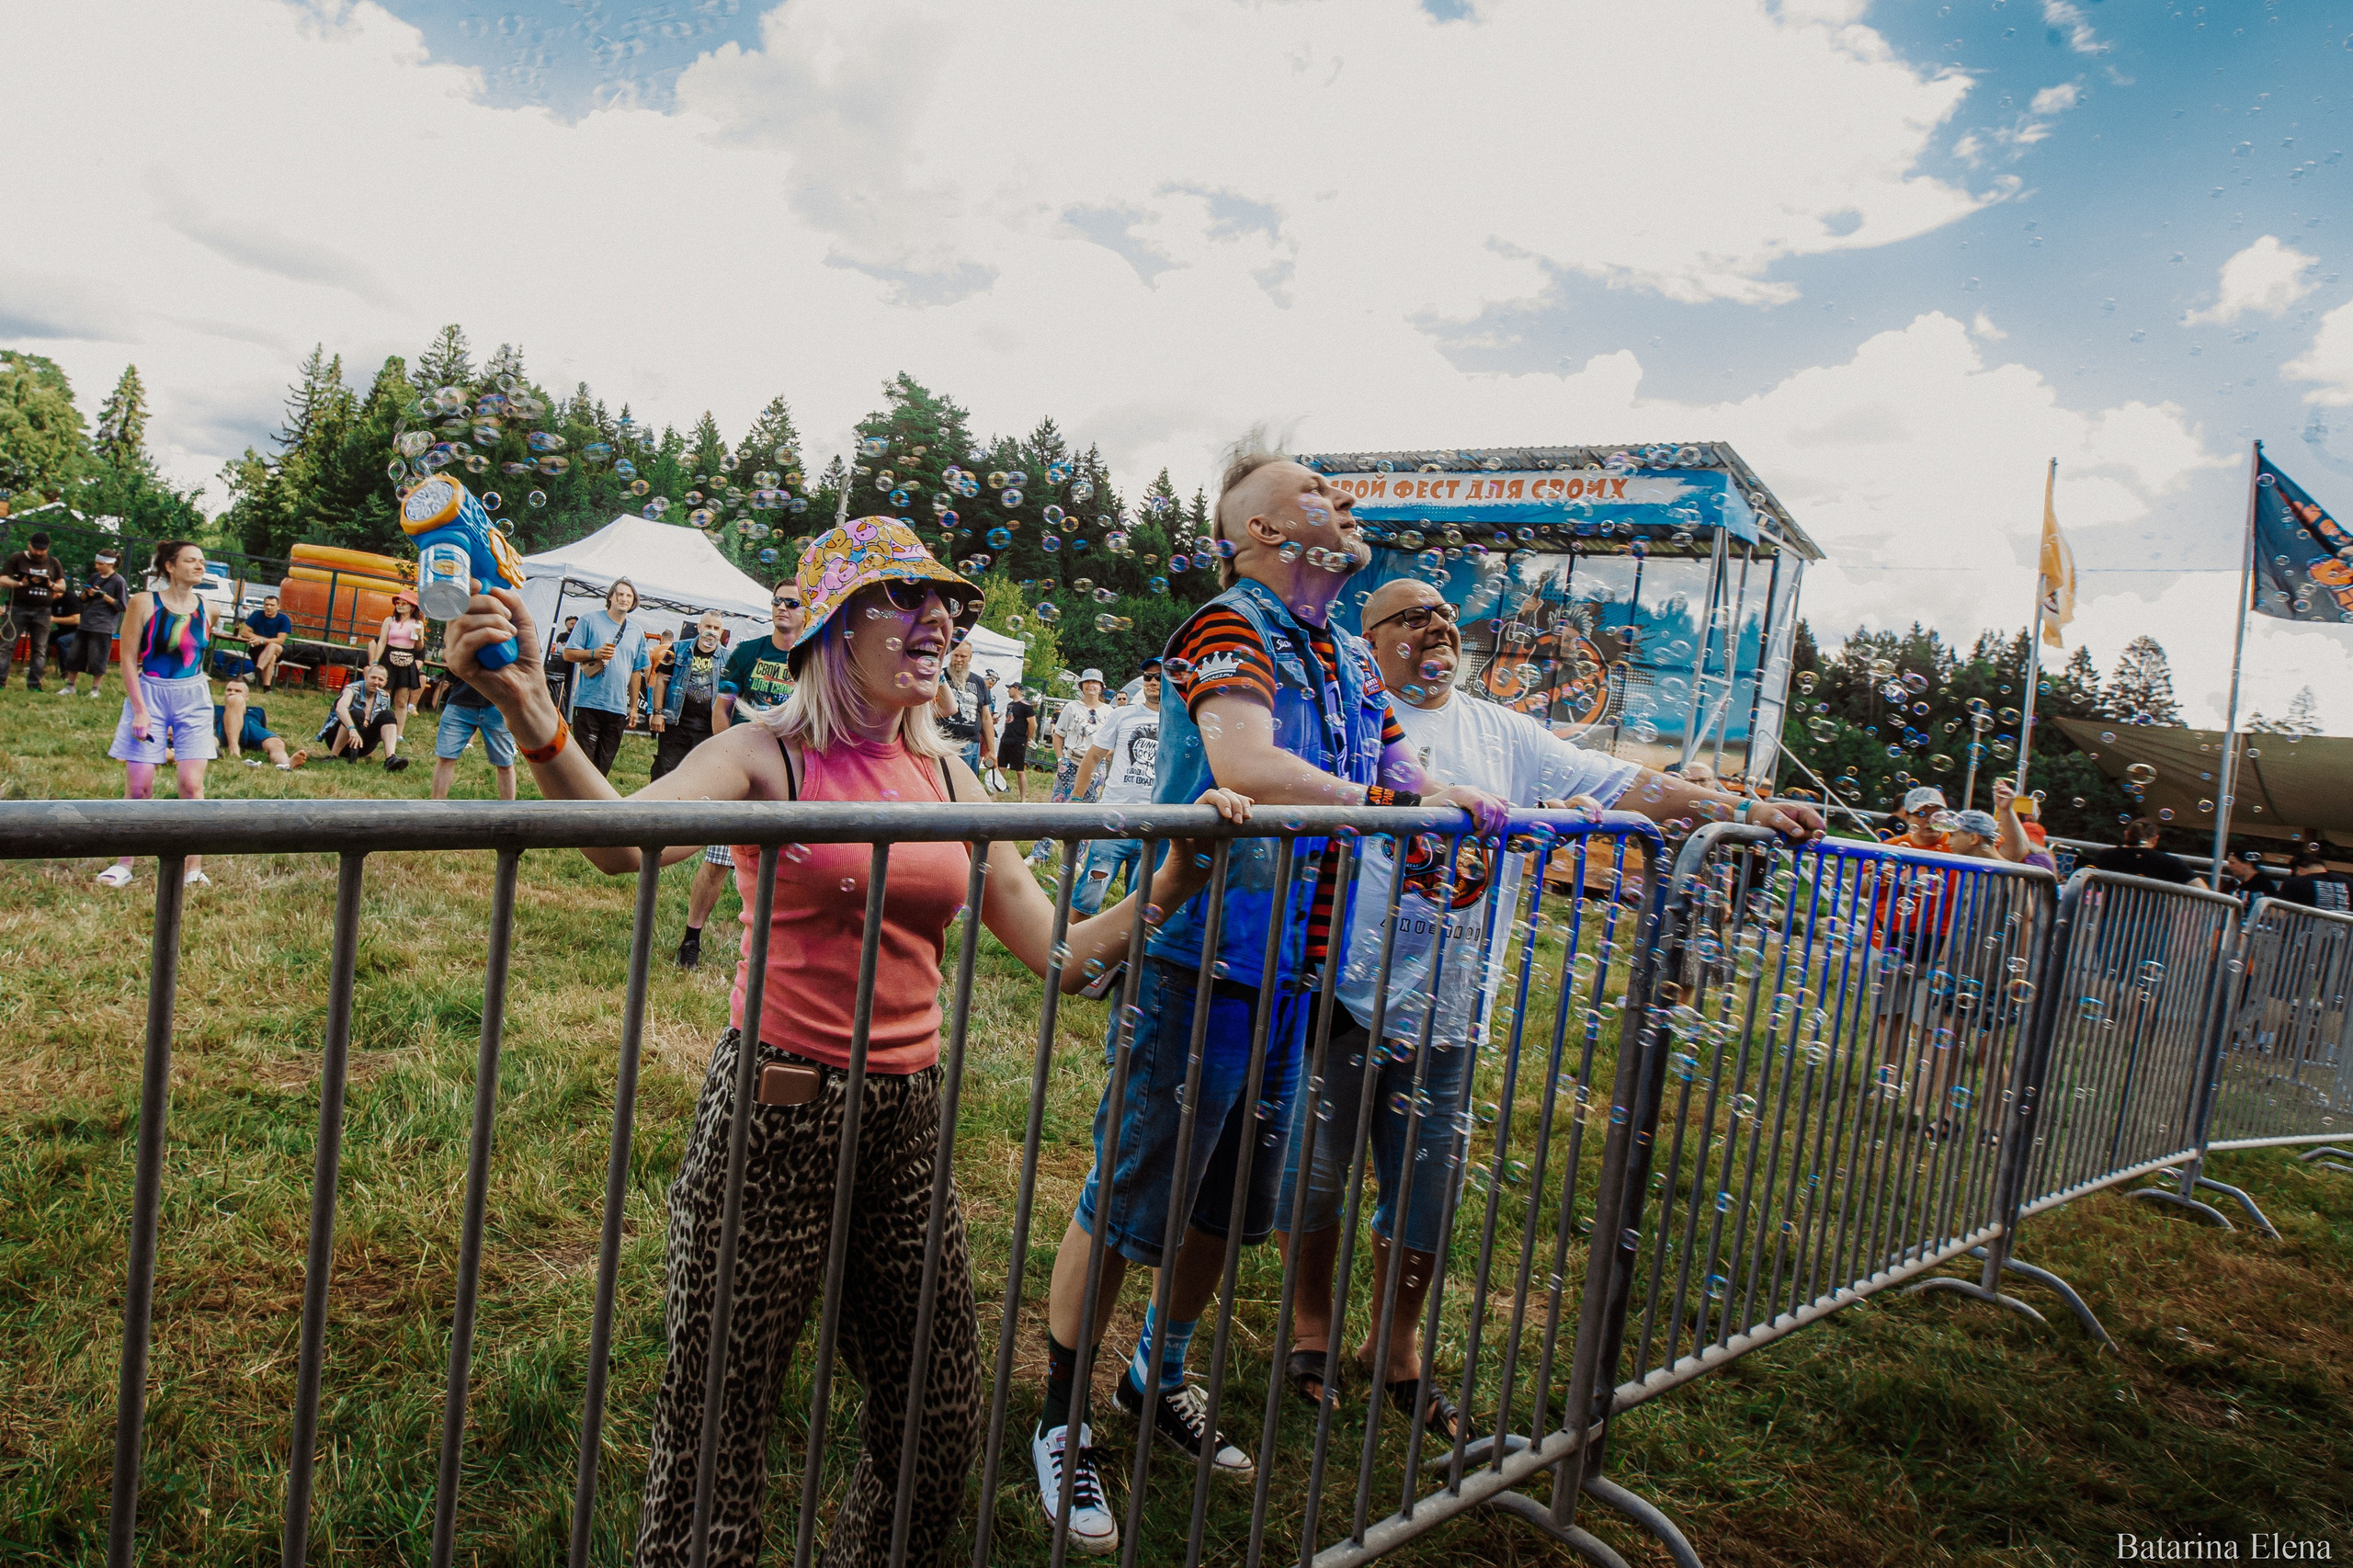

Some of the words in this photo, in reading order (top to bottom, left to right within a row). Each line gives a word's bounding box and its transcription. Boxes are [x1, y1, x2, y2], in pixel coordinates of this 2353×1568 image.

[1331, 474, 1387, 499] ВОЙ
[1392, 478, 1460, 499] ФЕСТ
[1465, 478, 1525, 500] ДЛЯ
[1530, 477, 1629, 500] СВОИХ
[756, 662, 781, 679] СВОЙ
[750, 677, 769, 693] ДЛЯ
[1134, 738, 1158, 751] PUNK
